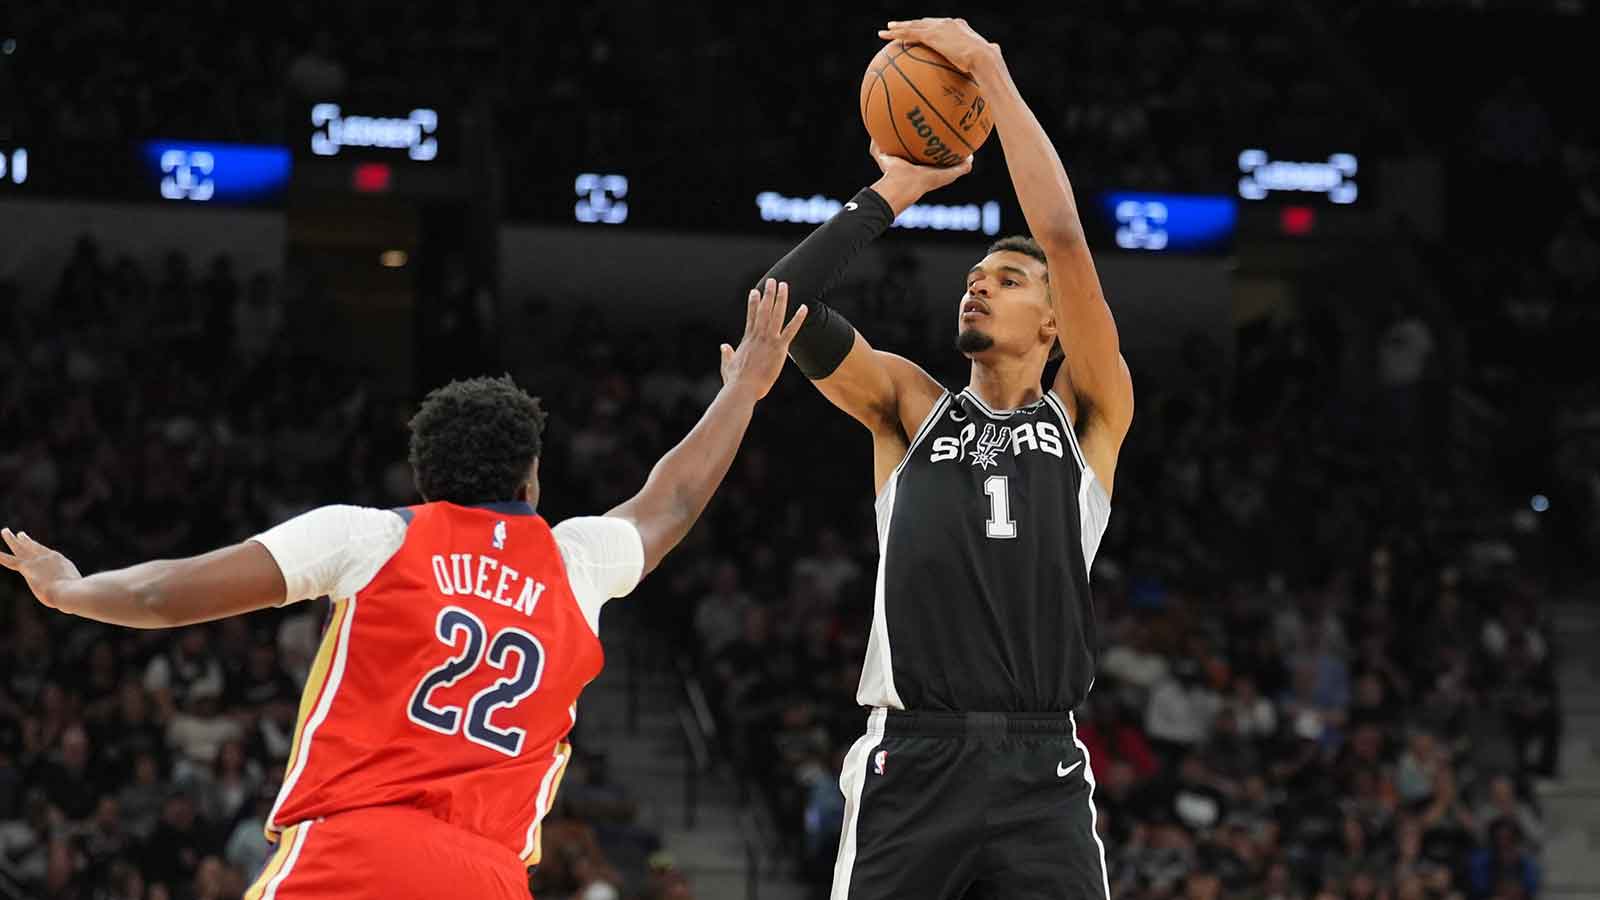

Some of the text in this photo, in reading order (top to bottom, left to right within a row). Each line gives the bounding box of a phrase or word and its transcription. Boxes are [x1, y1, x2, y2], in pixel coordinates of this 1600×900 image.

[906, 105, 962, 167] Wilson
[930, 421, 1064, 471] SPURS
[984, 475, 1017, 539] 1
[431, 553, 545, 617] QUEEN
[407, 606, 545, 757] 22
